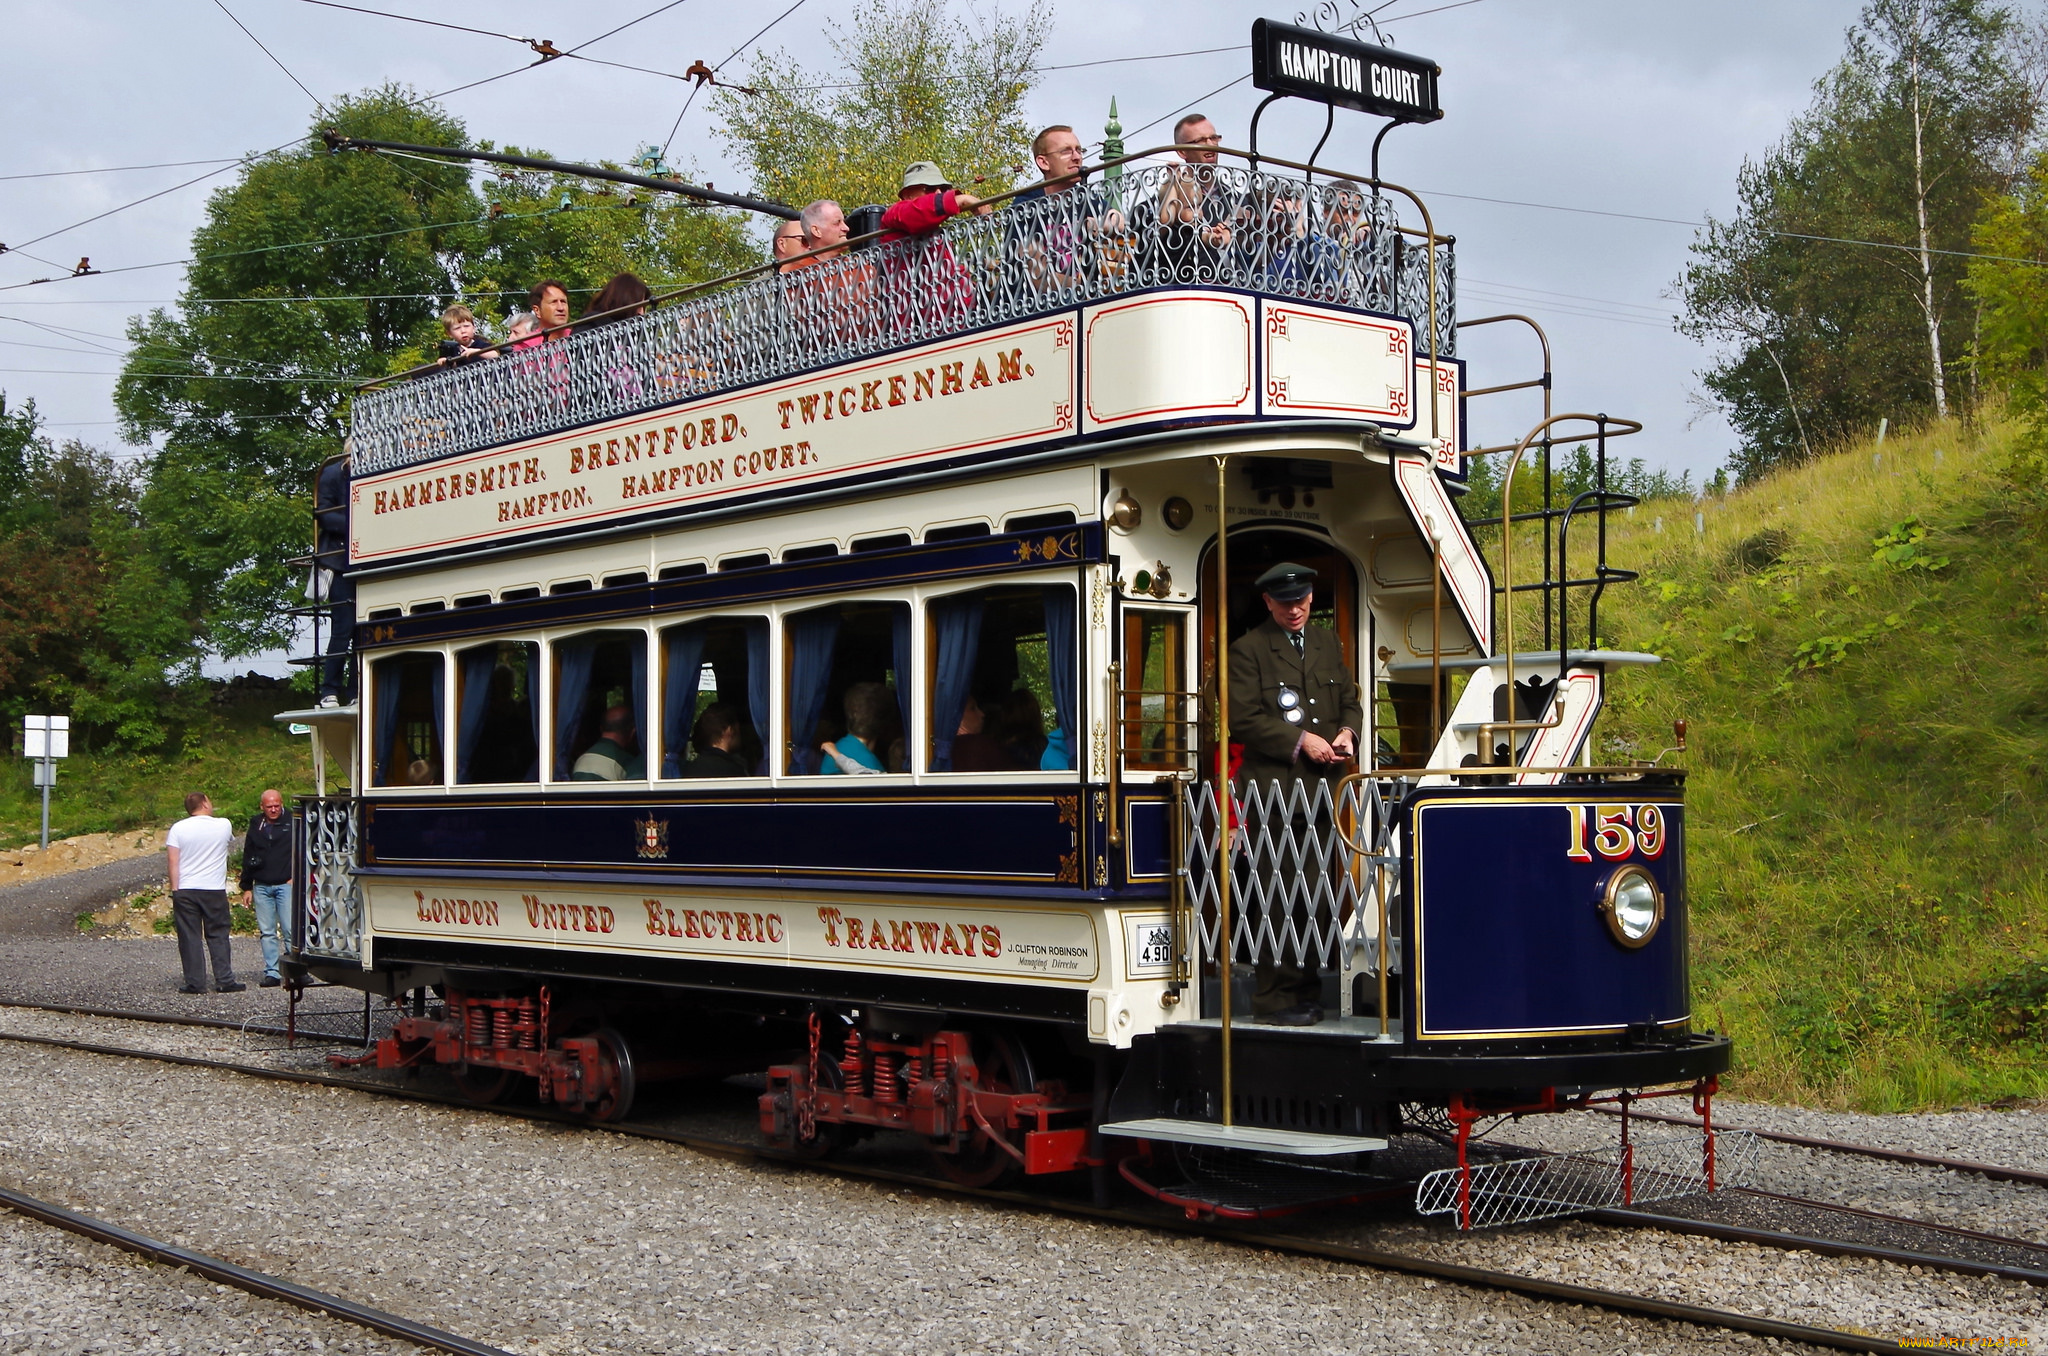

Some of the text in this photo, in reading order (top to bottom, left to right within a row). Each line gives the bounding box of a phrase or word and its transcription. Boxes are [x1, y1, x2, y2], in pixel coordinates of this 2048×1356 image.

[1280, 41, 1421, 107] HAMPTON COURT
[373, 348, 1035, 515] HAMMERSMITH. BRENTFORD. TWICKENHAM.
[497, 440, 819, 523] HAMPTON. HAMPTON COURT.
[1565, 804, 1666, 863] 159
[1018, 956, 1079, 971] Managing Director
[1048, 945, 1088, 957] ROBINSON
